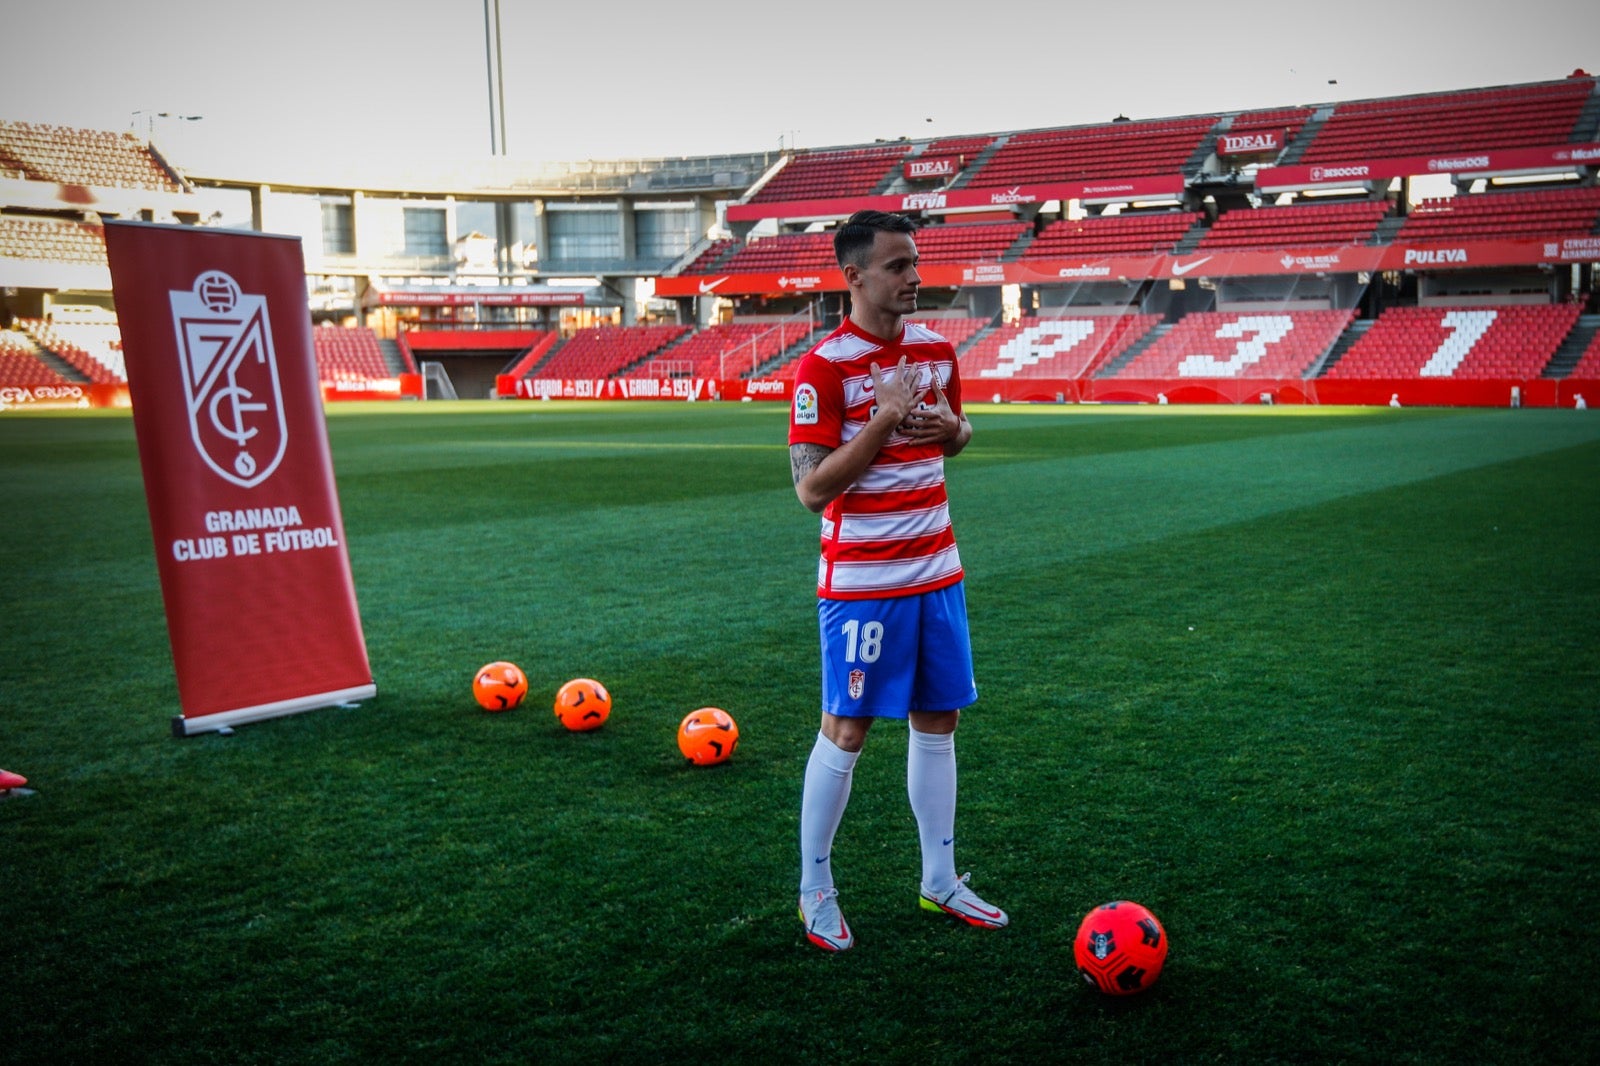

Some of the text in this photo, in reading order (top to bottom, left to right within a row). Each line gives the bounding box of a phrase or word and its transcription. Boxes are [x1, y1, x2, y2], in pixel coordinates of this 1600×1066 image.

[1224, 134, 1277, 150] IDEAL
[910, 161, 953, 174] IDEAL
[1404, 249, 1467, 264] PULEVA
[205, 506, 302, 532] GRANADA
[173, 526, 338, 562] CLUB DE FÚTBOL
[842, 619, 884, 663] 18
